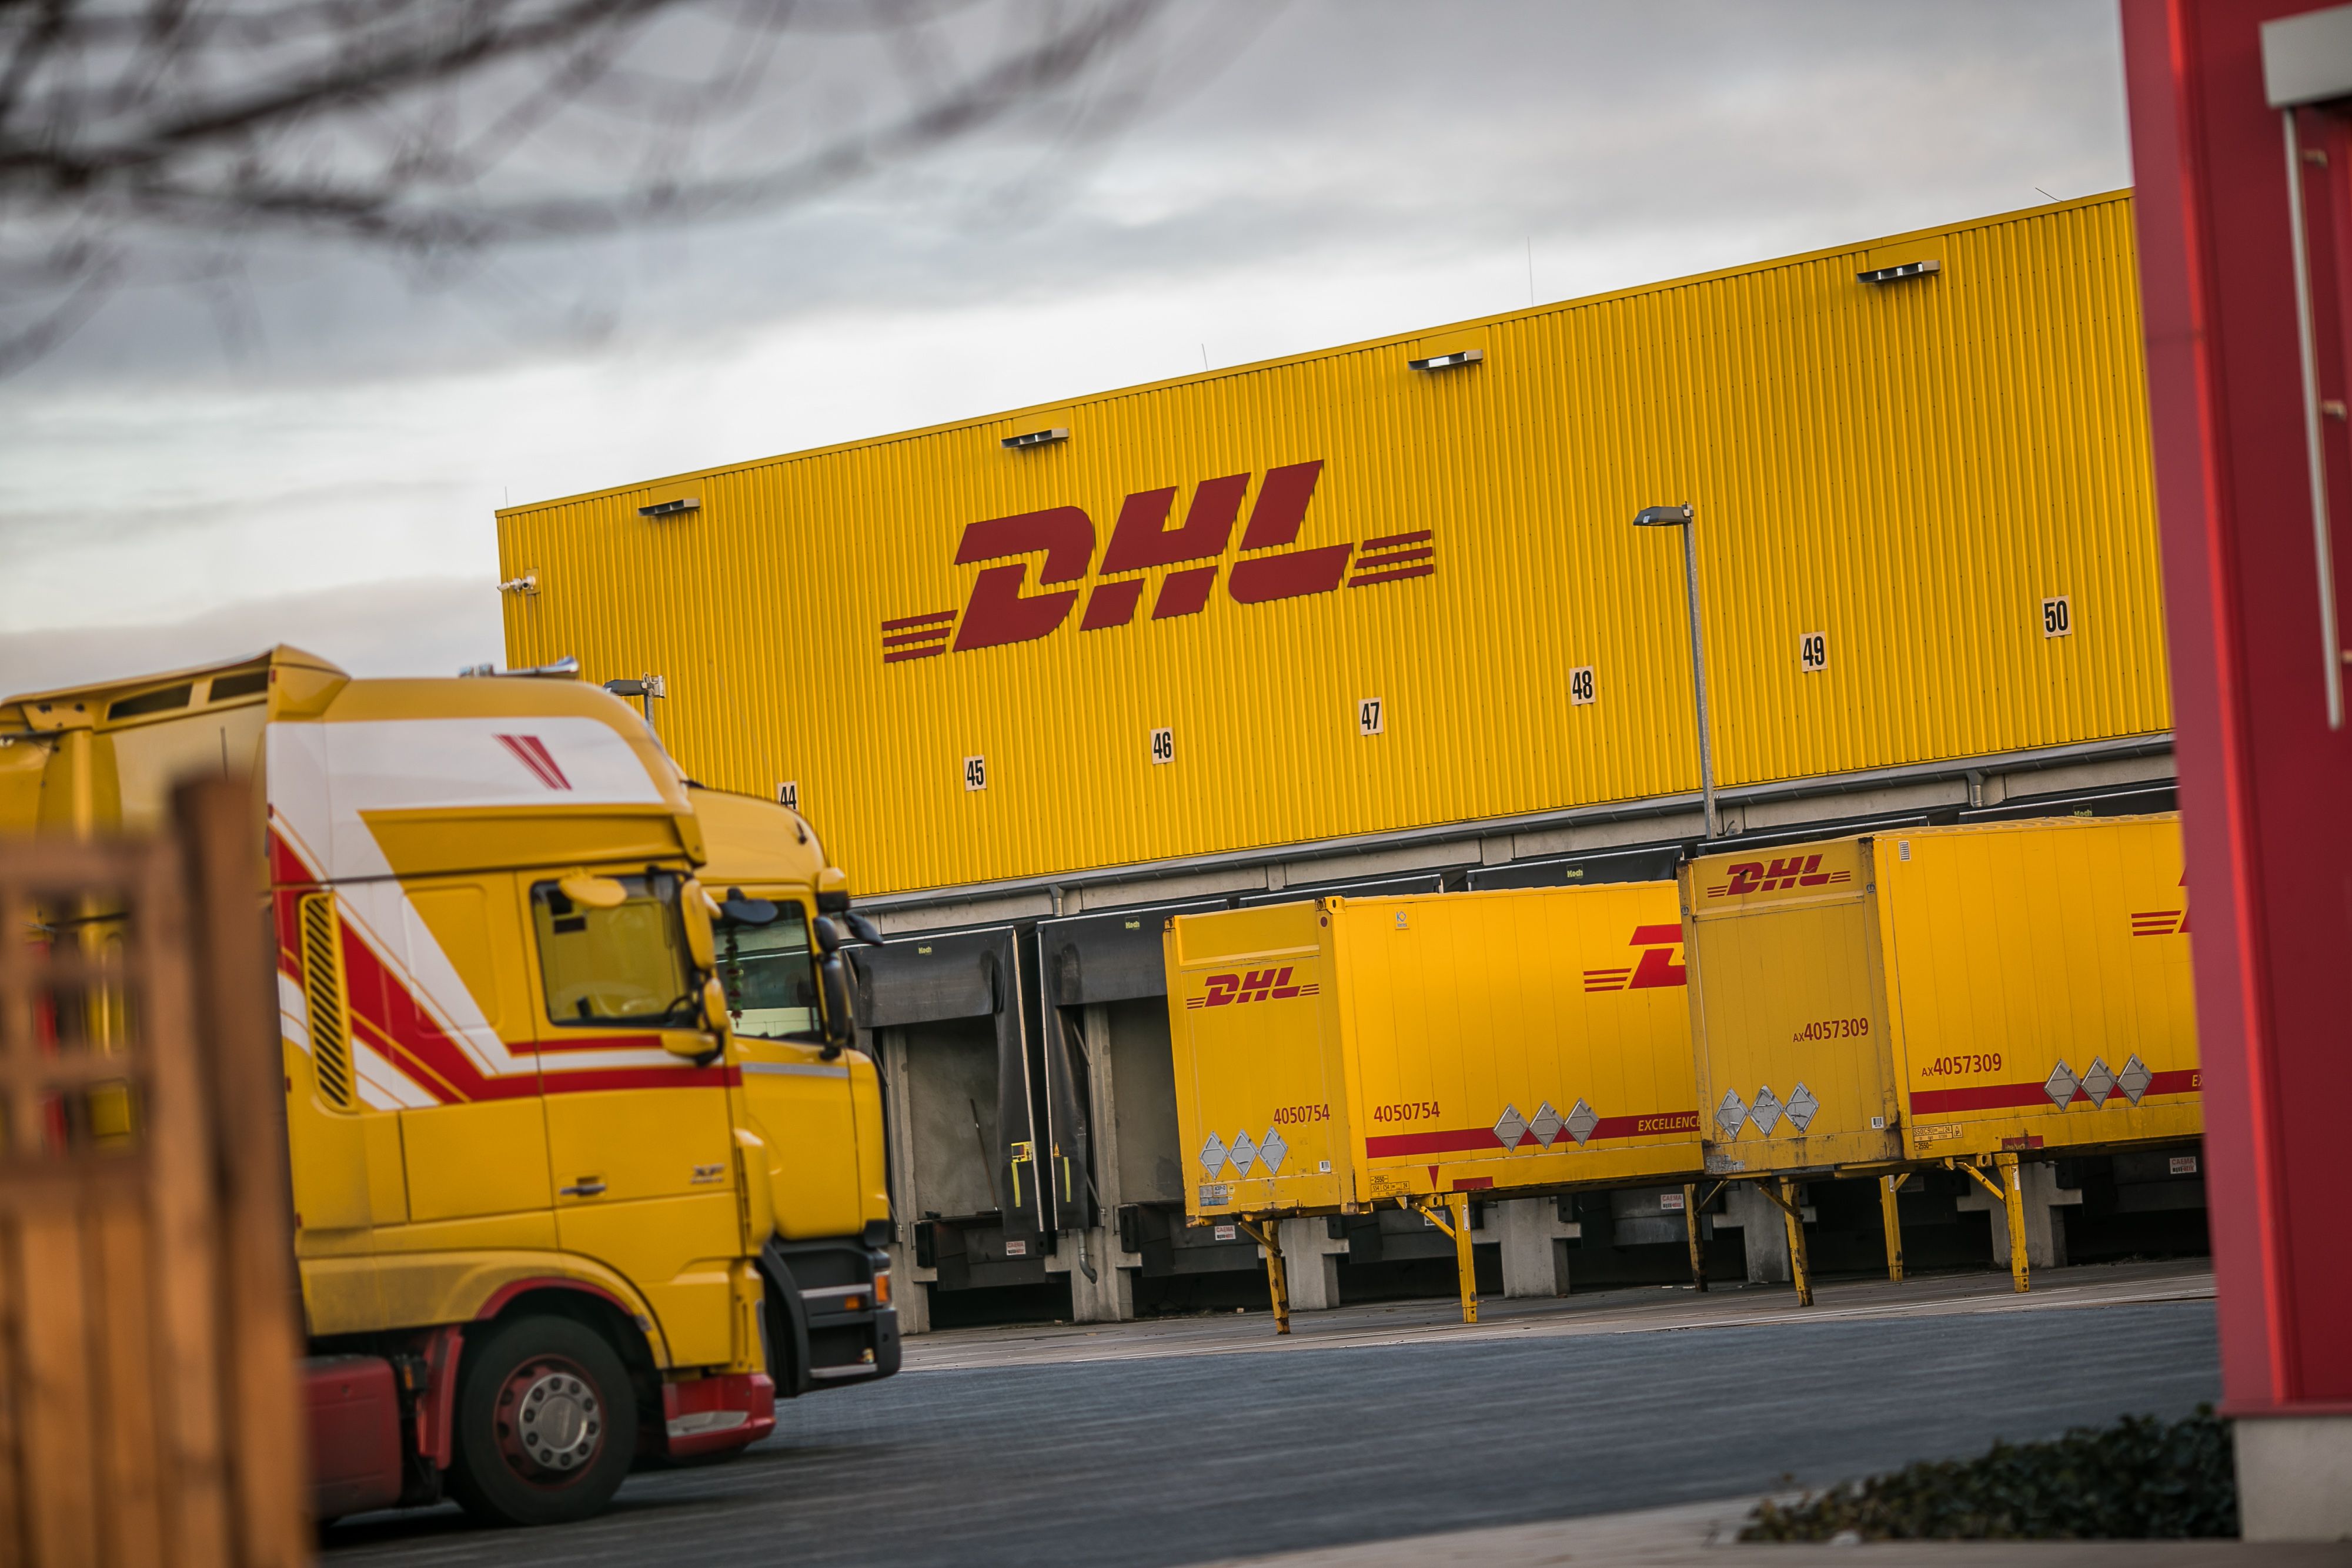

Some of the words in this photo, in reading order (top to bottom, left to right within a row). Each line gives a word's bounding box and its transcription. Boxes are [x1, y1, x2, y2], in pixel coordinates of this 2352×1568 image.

[953, 459, 1354, 652] DHL
[2044, 600, 2069, 633] 50
[1803, 636, 1825, 666] 49
[1572, 670, 1593, 700] 48
[1361, 701, 1380, 730] 47
[1153, 731, 1172, 759] 46
[967, 759, 984, 786] 45
[780, 785, 796, 810] 44
[1567, 869, 1583, 878] Koch
[1726, 854, 1831, 895] DHL
[1125, 921, 1140, 929] Koch
[1204, 967, 1301, 1007] DHL
[1793, 1018, 1869, 1042] AX4057309
[1922, 1053, 2002, 1076] AX4057309
[1274, 1104, 1330, 1124] 4050754
[1374, 1101, 1441, 1122] 4050754
